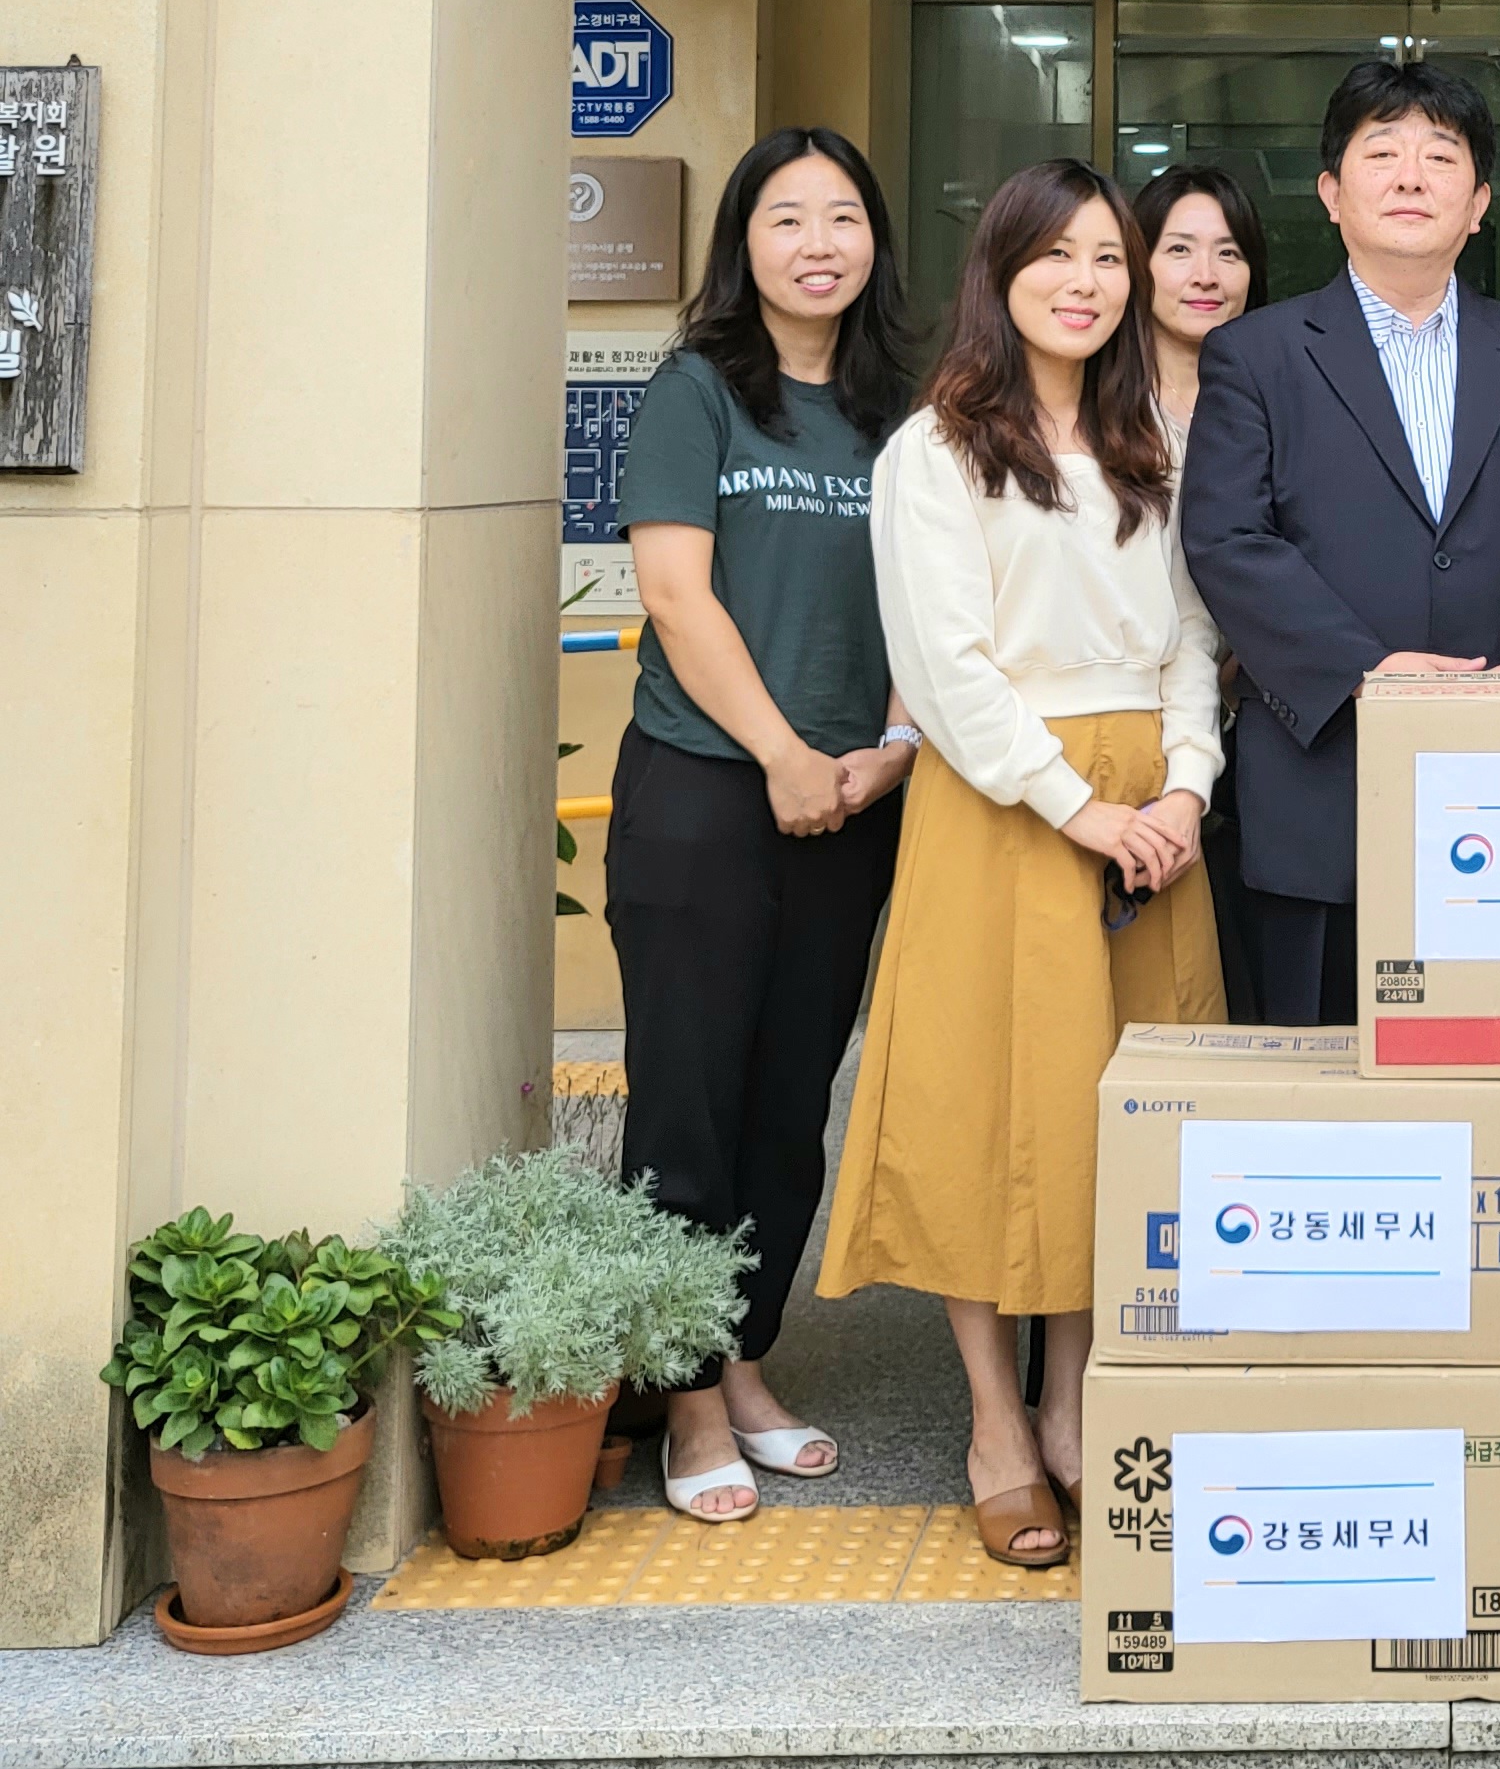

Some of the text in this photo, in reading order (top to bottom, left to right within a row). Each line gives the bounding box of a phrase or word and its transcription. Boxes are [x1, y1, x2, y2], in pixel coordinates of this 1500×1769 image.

[574, 14, 641, 26] 스경비구역
[573, 41, 650, 88] ADT
[0, 101, 67, 129] 복지회
[718, 466, 817, 496] ARMANI
[766, 494, 825, 514] MILANO
[1380, 976, 1420, 986] 208055
[1383, 990, 1418, 1001] 24개입
[1142, 1101, 1197, 1112] LOTTE
[1269, 1210, 1436, 1241] 강동세무서
[1262, 1518, 1430, 1550] 강동세무서
[1115, 1635, 1167, 1649] 159489
[1119, 1653, 1164, 1670] 10개입
